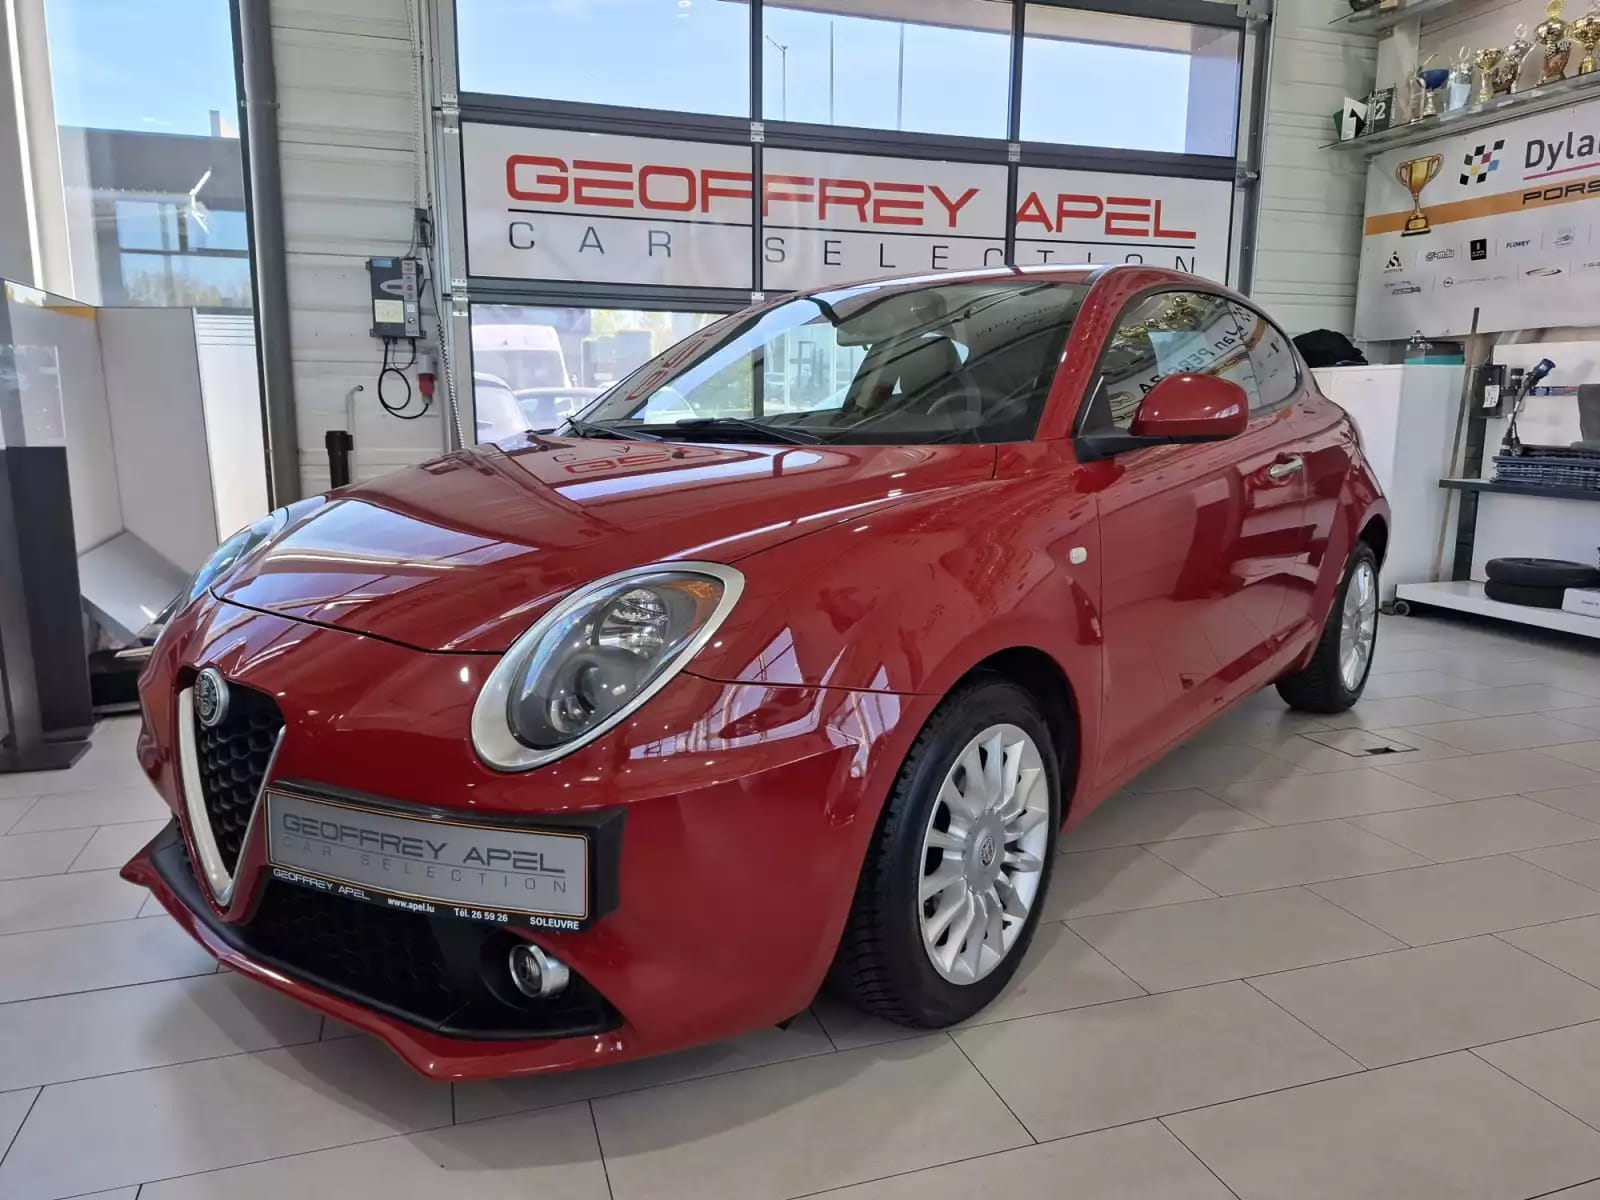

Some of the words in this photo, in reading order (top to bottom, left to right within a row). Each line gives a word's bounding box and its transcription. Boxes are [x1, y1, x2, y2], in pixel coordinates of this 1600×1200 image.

[1525, 131, 1600, 171] Dyla
[506, 154, 980, 228] GEOFFREY
[1016, 191, 1197, 239] APEL
[508, 221, 672, 258] CAR
[283, 813, 448, 860] GEOFFREY
[462, 846, 565, 873] APEL
[283, 836, 332, 856] CAR
[360, 854, 566, 893] SELECTION
[272, 868, 333, 890] GEOFFREY
[338, 885, 371, 901] APEL
[387, 897, 436, 913] www.apel.lu
[471, 910, 482, 919] 26
[484, 912, 496, 921] 59
[497, 914, 509, 922] 26
[529, 917, 580, 931] SOLEUVRE
